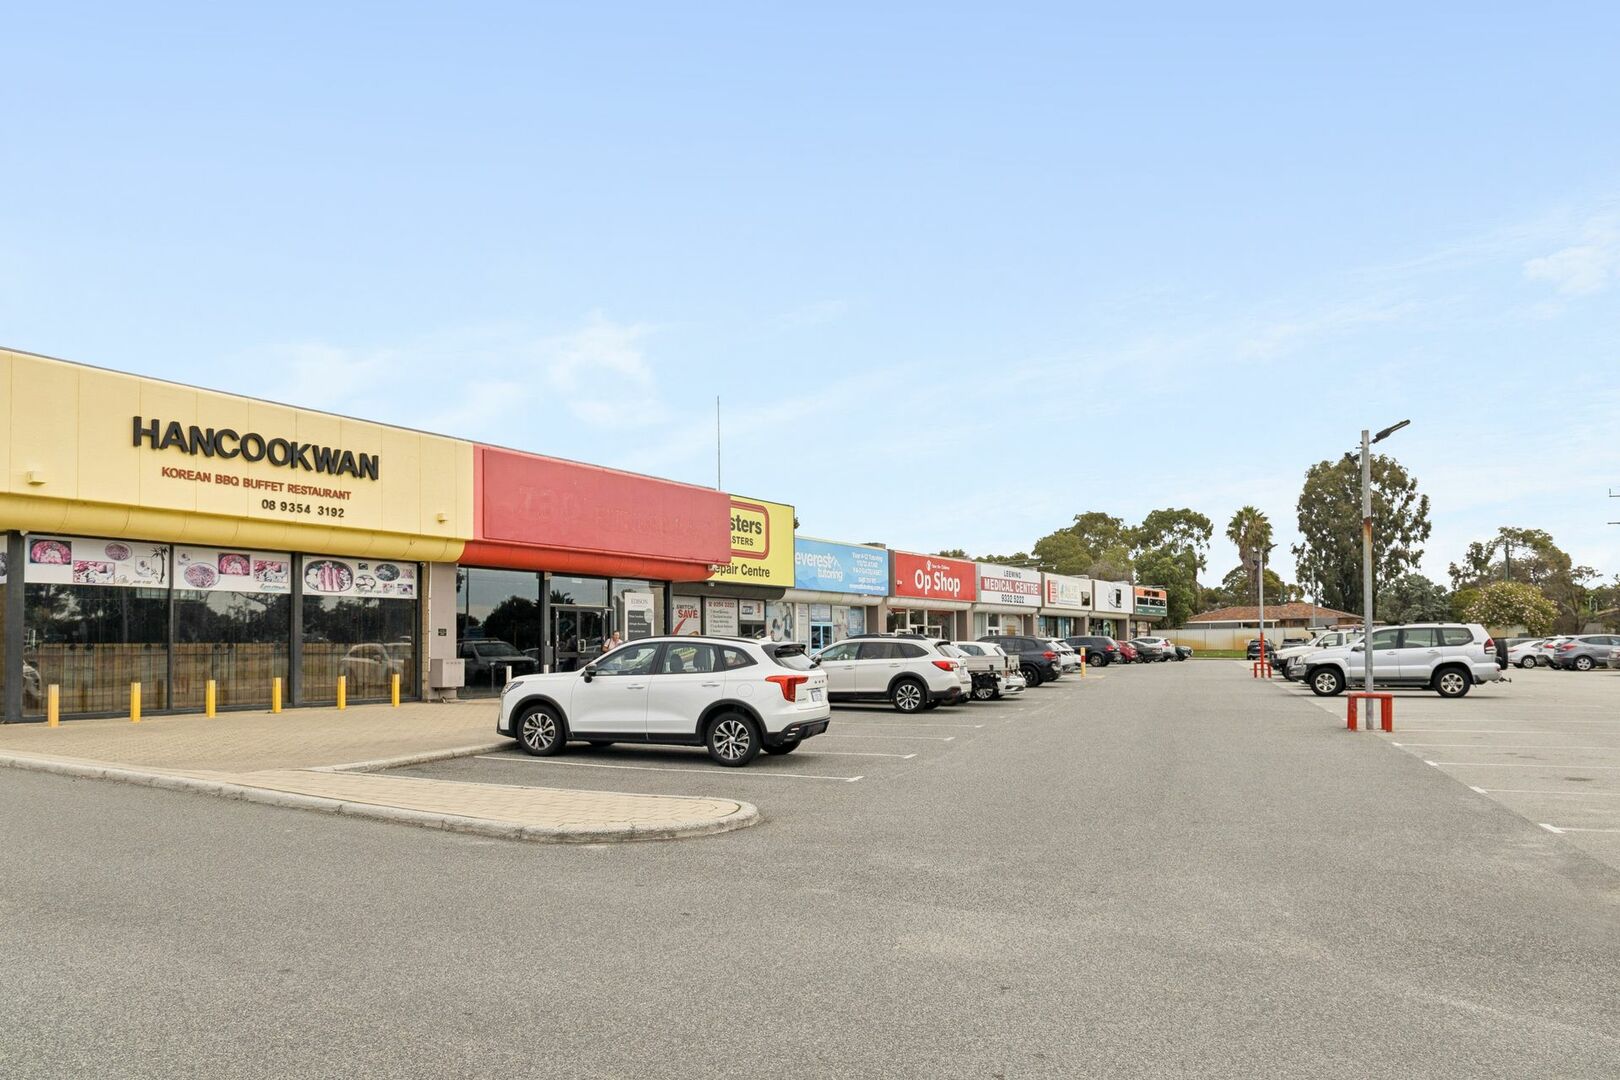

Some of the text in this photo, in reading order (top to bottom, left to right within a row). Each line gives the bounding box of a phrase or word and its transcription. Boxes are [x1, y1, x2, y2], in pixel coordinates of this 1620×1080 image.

[132, 415, 379, 480] HANCOOKWAN
[161, 466, 352, 500] KOREAN BBQ BUFFET RESTAURANT
[261, 499, 345, 518] 08 9354 3192
[730, 514, 762, 535] sters
[731, 535, 754, 546] STERS
[795, 552, 833, 568] everest
[713, 563, 770, 578] epair Centre
[817, 567, 843, 582] tutoring
[914, 569, 961, 597] Op Shop
[984, 578, 1013, 592] MEDICAL
[1015, 582, 1038, 595] CENTRE
[678, 609, 699, 619] SAVE
